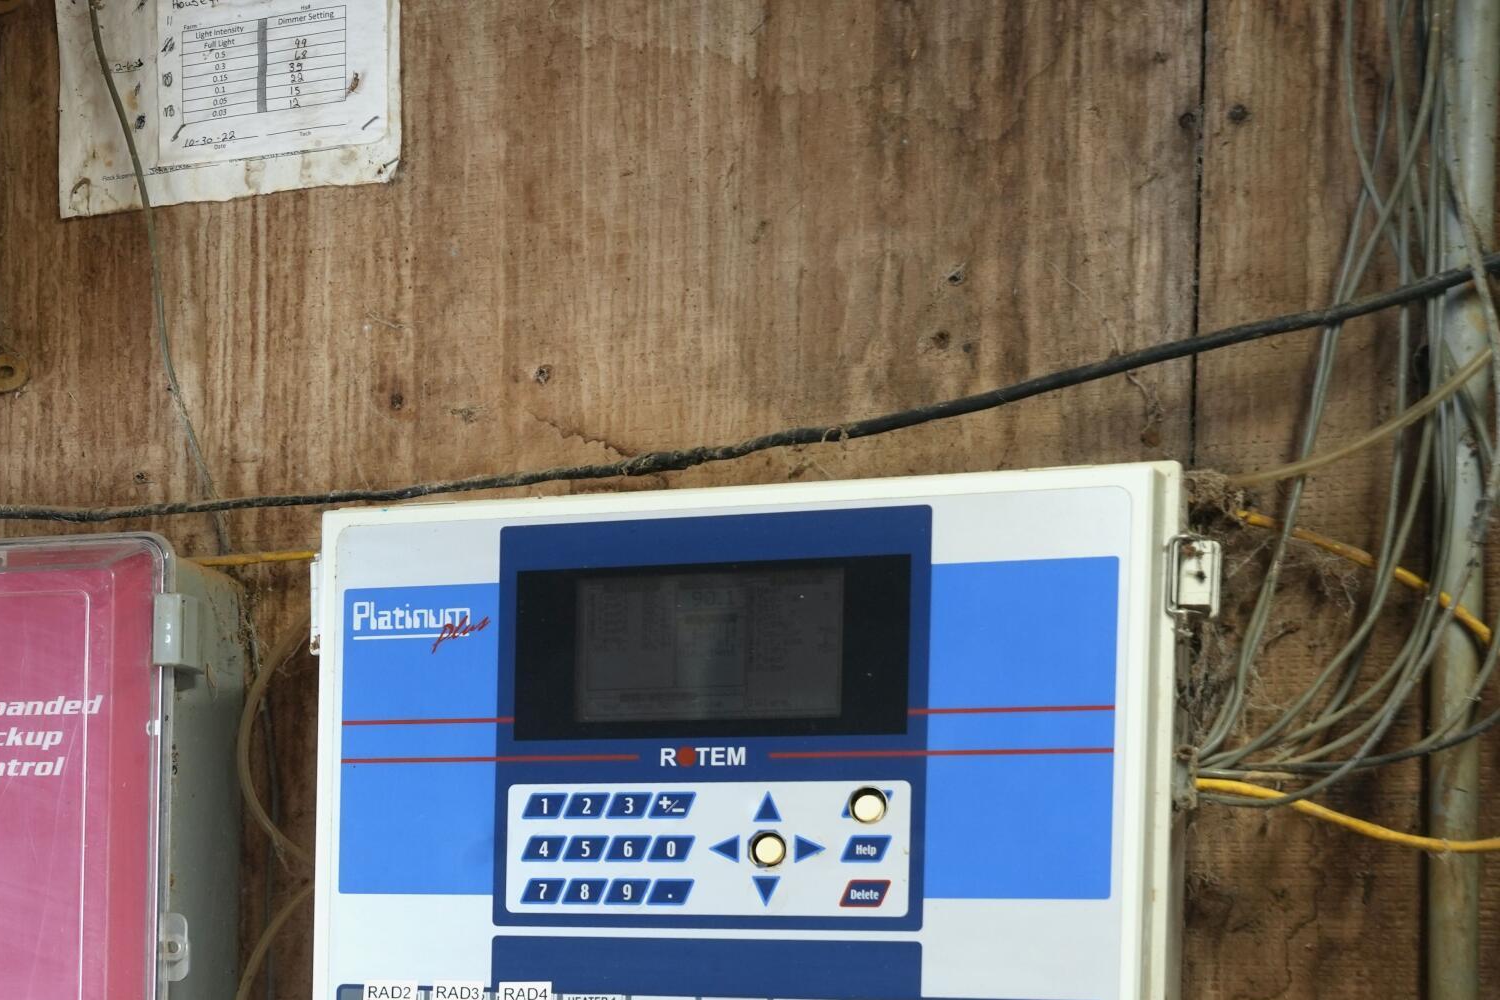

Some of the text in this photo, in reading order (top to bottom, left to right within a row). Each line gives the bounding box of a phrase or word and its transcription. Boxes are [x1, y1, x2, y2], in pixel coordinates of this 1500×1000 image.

[278, 11, 334, 26] Dimmer Setting
[195, 25, 244, 40] Light Intensity
[204, 38, 235, 49] Full Light
[215, 51, 226, 59] 0.5
[215, 63, 226, 71] 0.3
[213, 74, 228, 83] 0.15
[214, 86, 226, 94] 0.1
[213, 98, 228, 106] 0.05
[212, 109, 227, 117] 0.03
[352, 601, 490, 654] Platinum plus
[541, 798, 548, 815] 1
[582, 798, 591, 815] 2
[624, 798, 633, 815] 3
[855, 843, 877, 858] Help
[850, 888, 879, 901] Delete
[367, 986, 411, 999] RAD2
[436, 986, 479, 1000] RAD3
[503, 988, 548, 1000] RAD4
